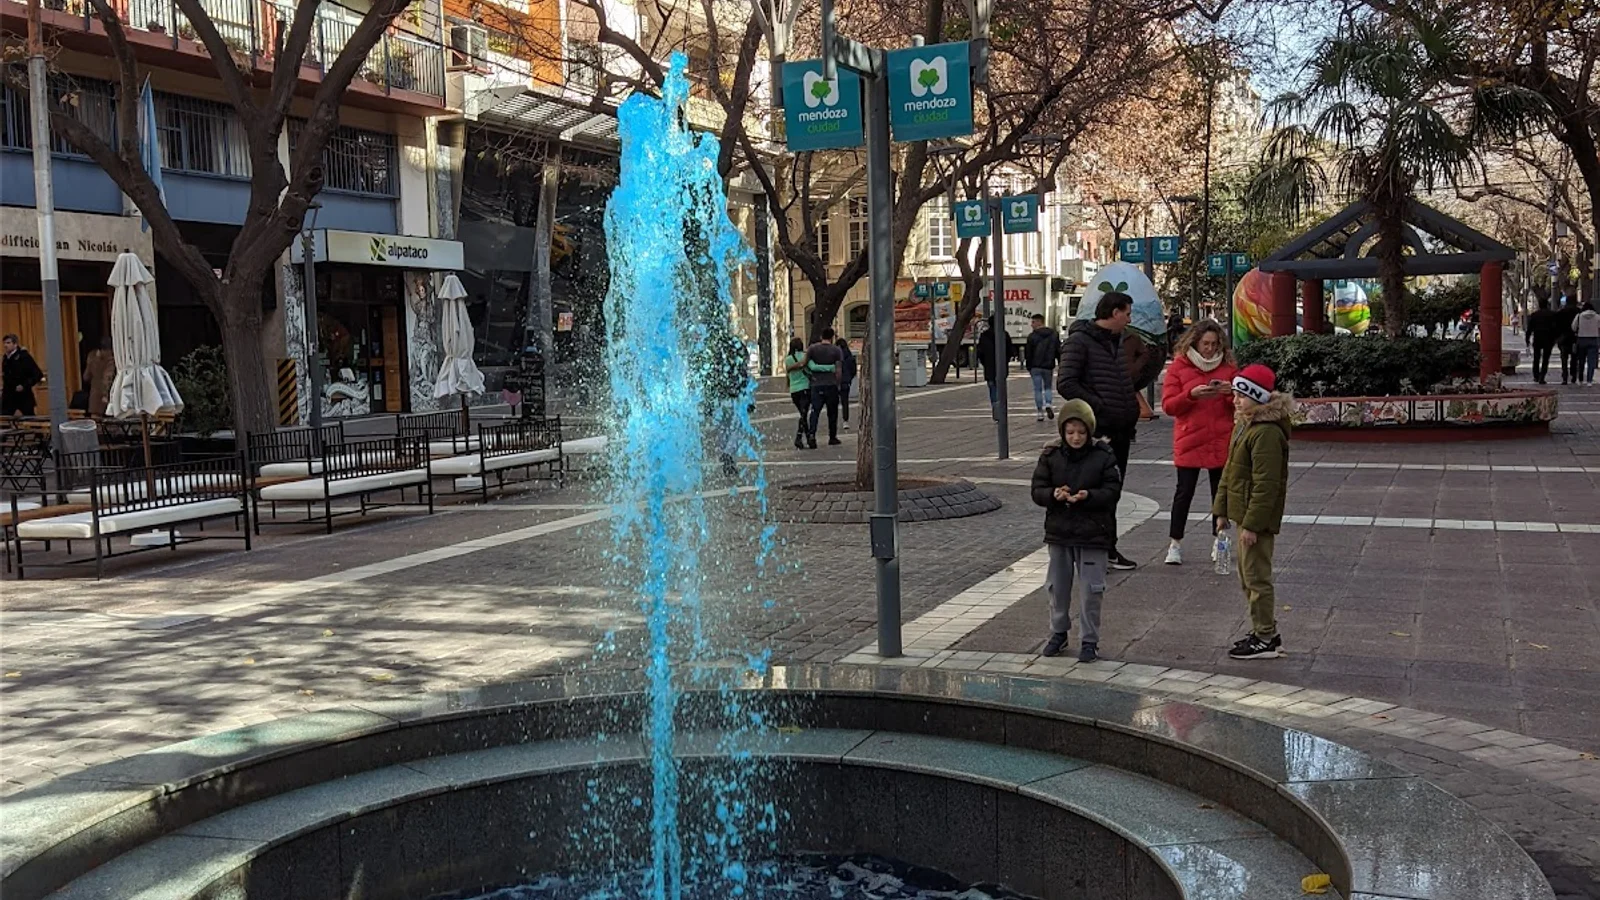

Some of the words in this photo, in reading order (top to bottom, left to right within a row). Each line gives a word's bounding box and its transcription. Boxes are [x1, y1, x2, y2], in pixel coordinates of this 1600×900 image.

[904, 97, 957, 112] mendoza
[798, 107, 848, 123] mendoza
[913, 110, 949, 124] ciudad
[806, 120, 841, 134] ciudad
[1, 234, 40, 249] dificio
[55, 239, 70, 251] an
[78, 239, 118, 253] Nicolás
[388, 241, 428, 260] alpataco
[988, 288, 1035, 302] FIAR
[1236, 381, 1263, 400] ON
